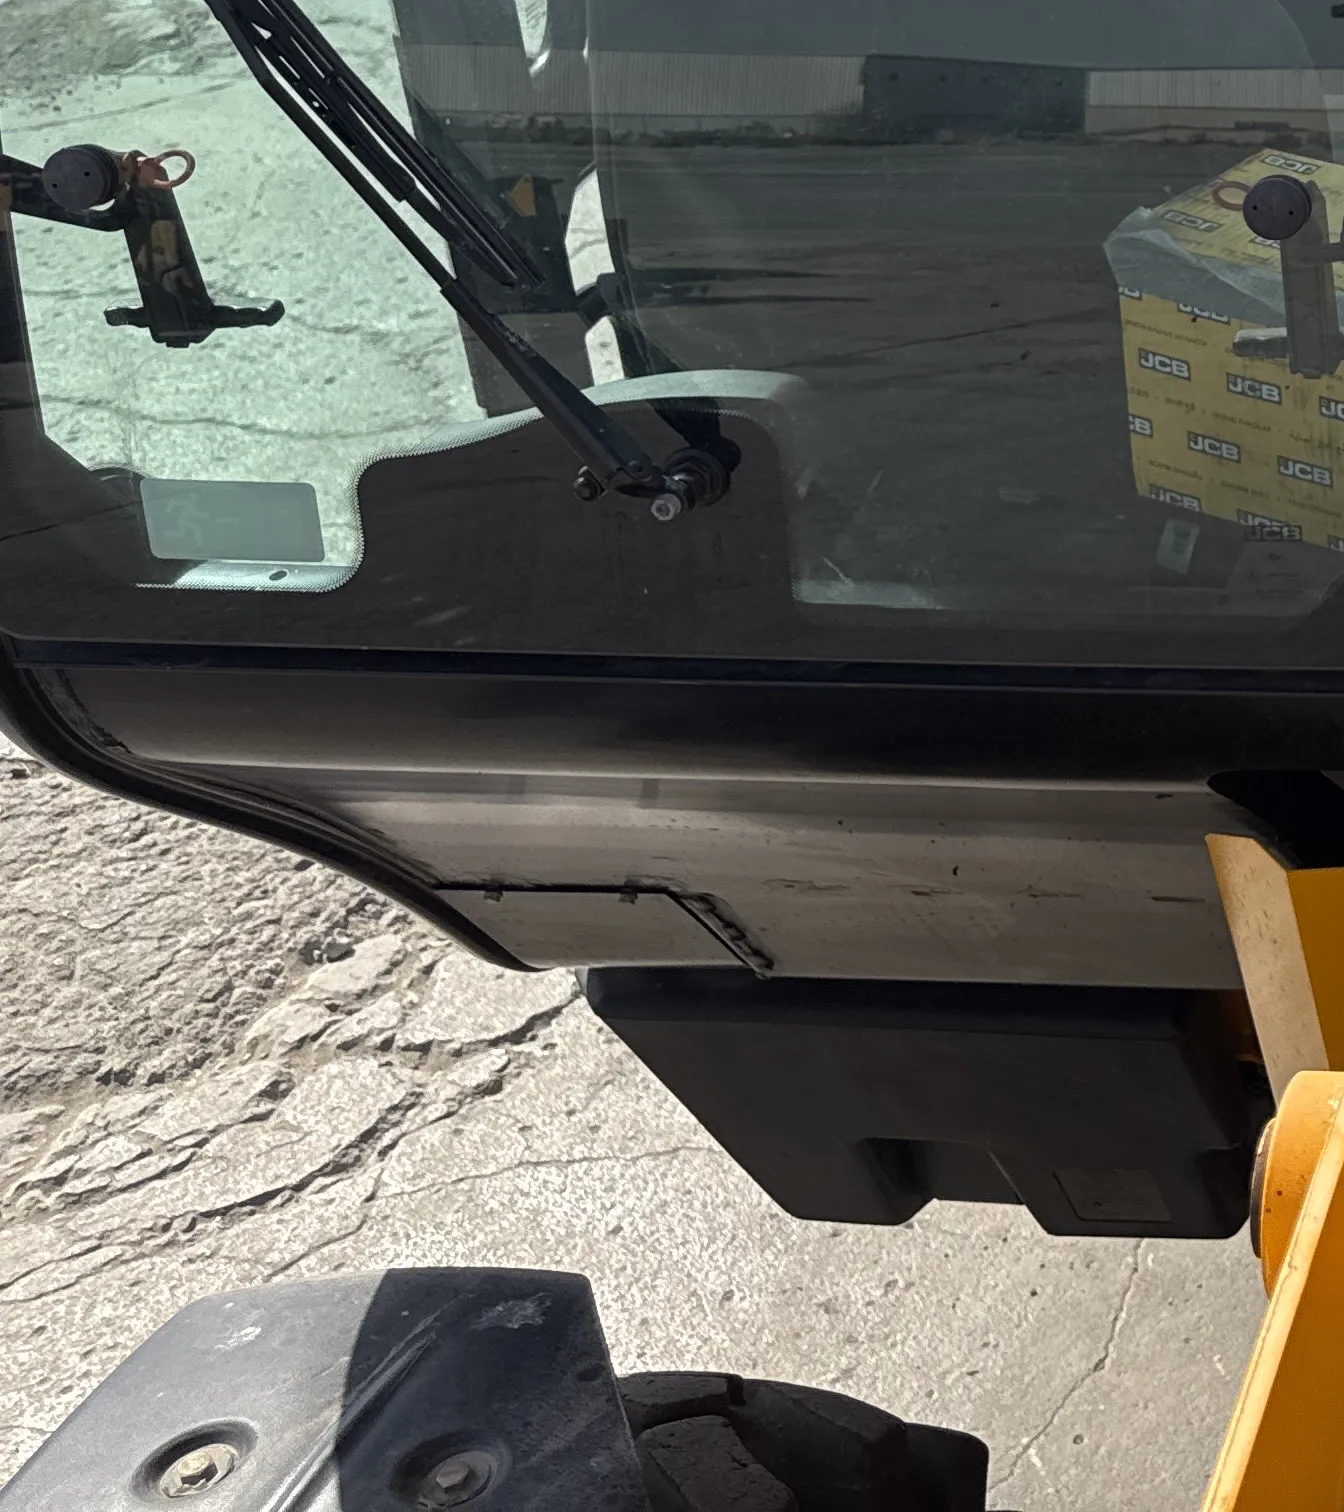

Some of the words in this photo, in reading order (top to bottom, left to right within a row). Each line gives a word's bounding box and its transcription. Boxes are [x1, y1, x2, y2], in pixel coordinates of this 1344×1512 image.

[1265, 155, 1317, 173] JCB
[1164, 211, 1215, 230] JCB
[1140, 353, 1189, 378] JCB
[1228, 376, 1280, 402] JCB
[1190, 435, 1239, 460] JCB
[1280, 459, 1331, 486] JCB
